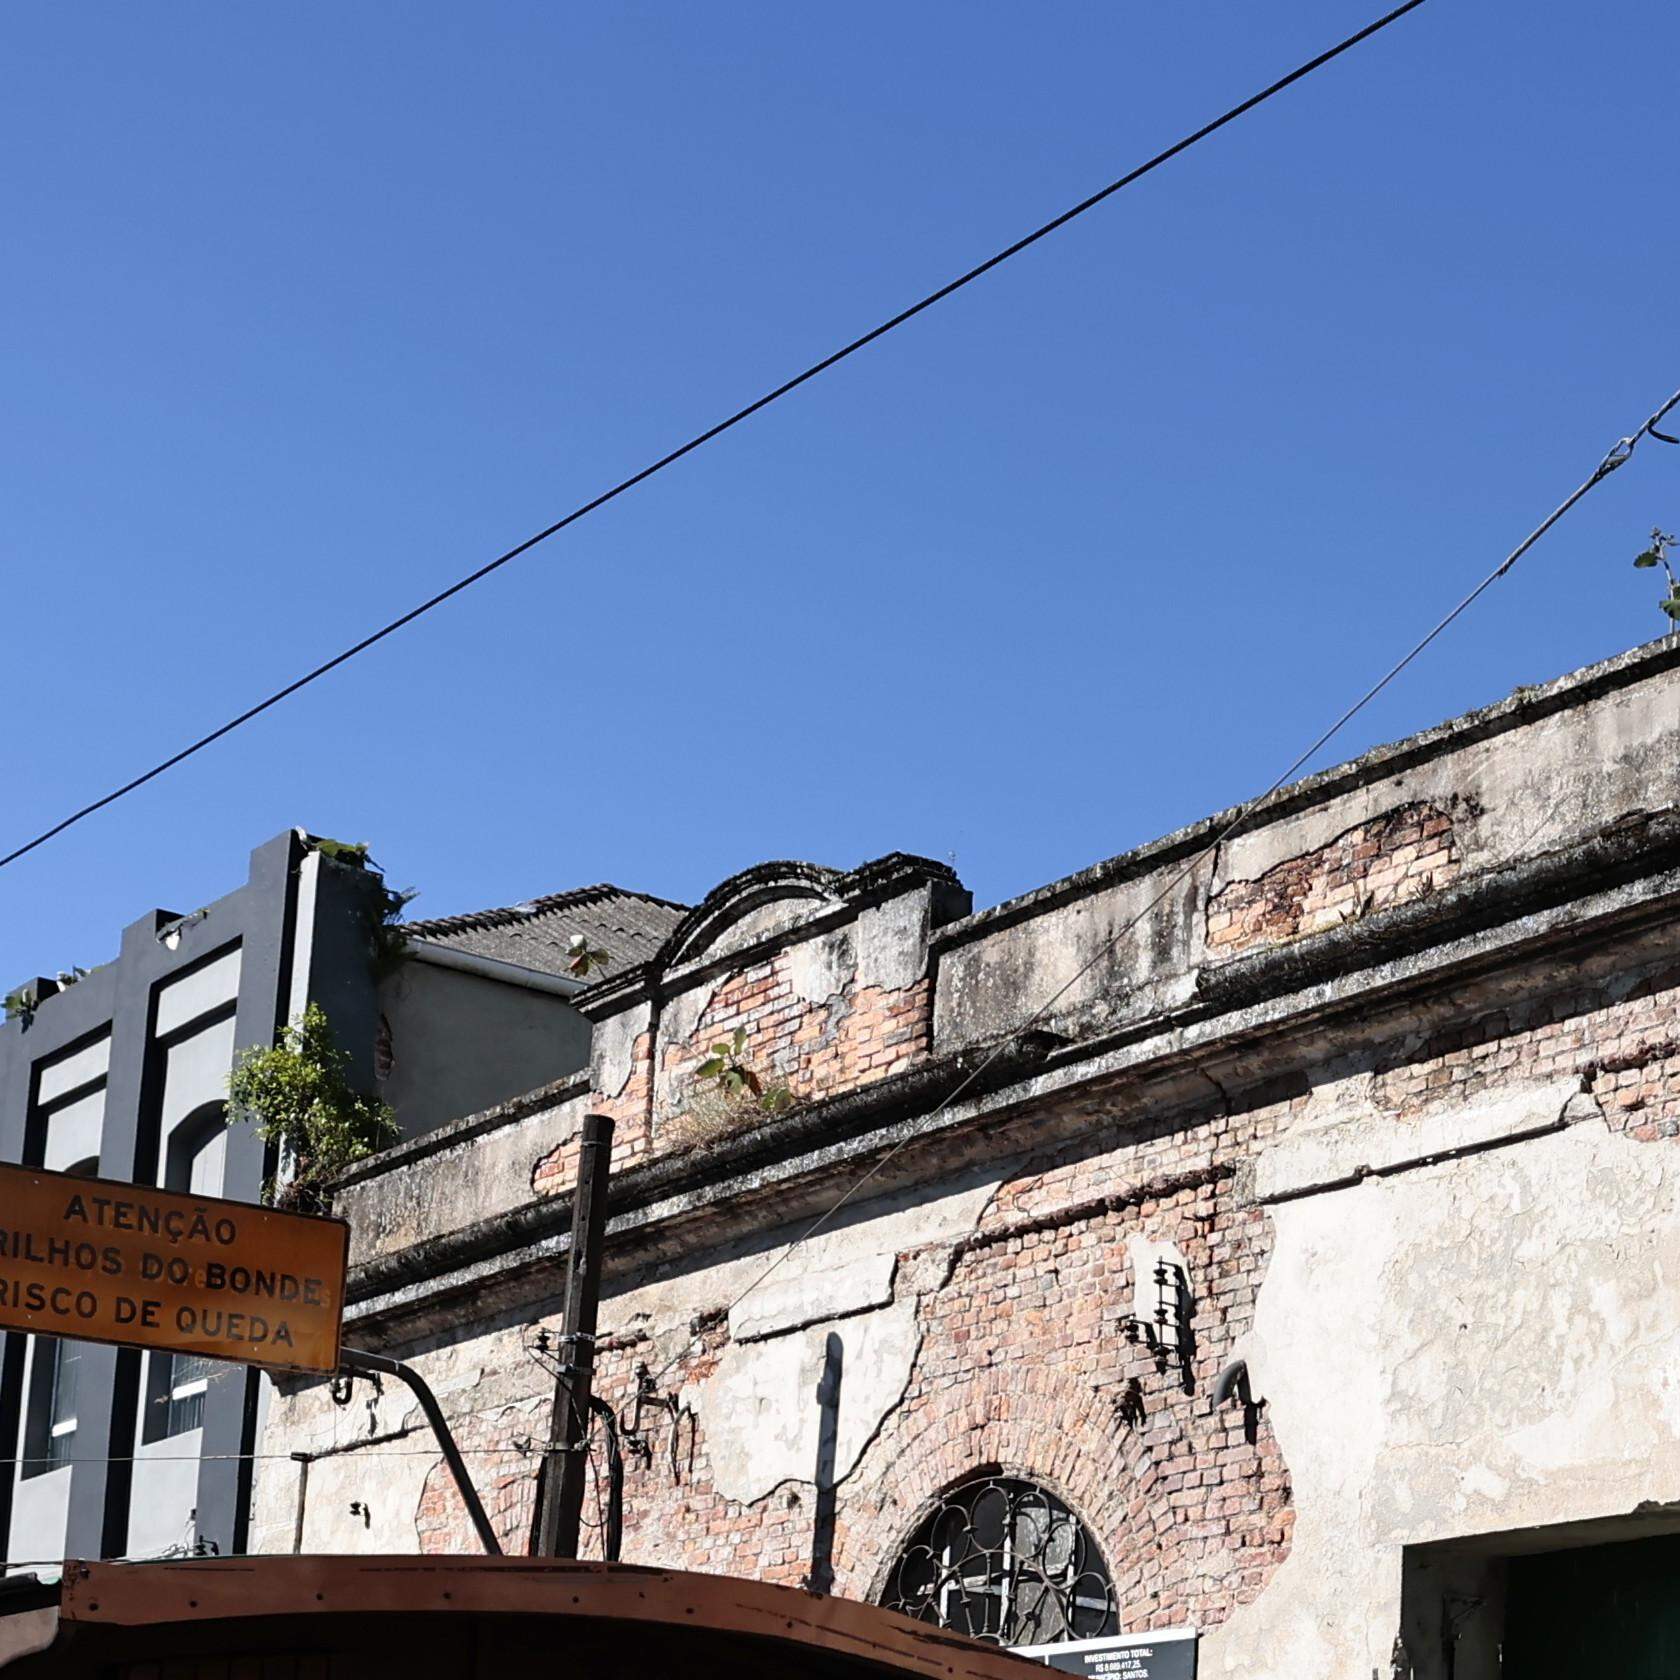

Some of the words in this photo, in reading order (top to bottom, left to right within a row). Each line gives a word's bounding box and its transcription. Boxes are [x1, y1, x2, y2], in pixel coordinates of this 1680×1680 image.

[63, 1194, 236, 1245] ATENÇÃO
[140, 1252, 189, 1285] DO
[205, 1262, 323, 1306] BONDE
[114, 1296, 162, 1328] DE
[175, 1305, 294, 1348] QUEDA
[1084, 1650, 1130, 1663] INVESTIMENTO
[1130, 1648, 1153, 1657] TOTAL:
